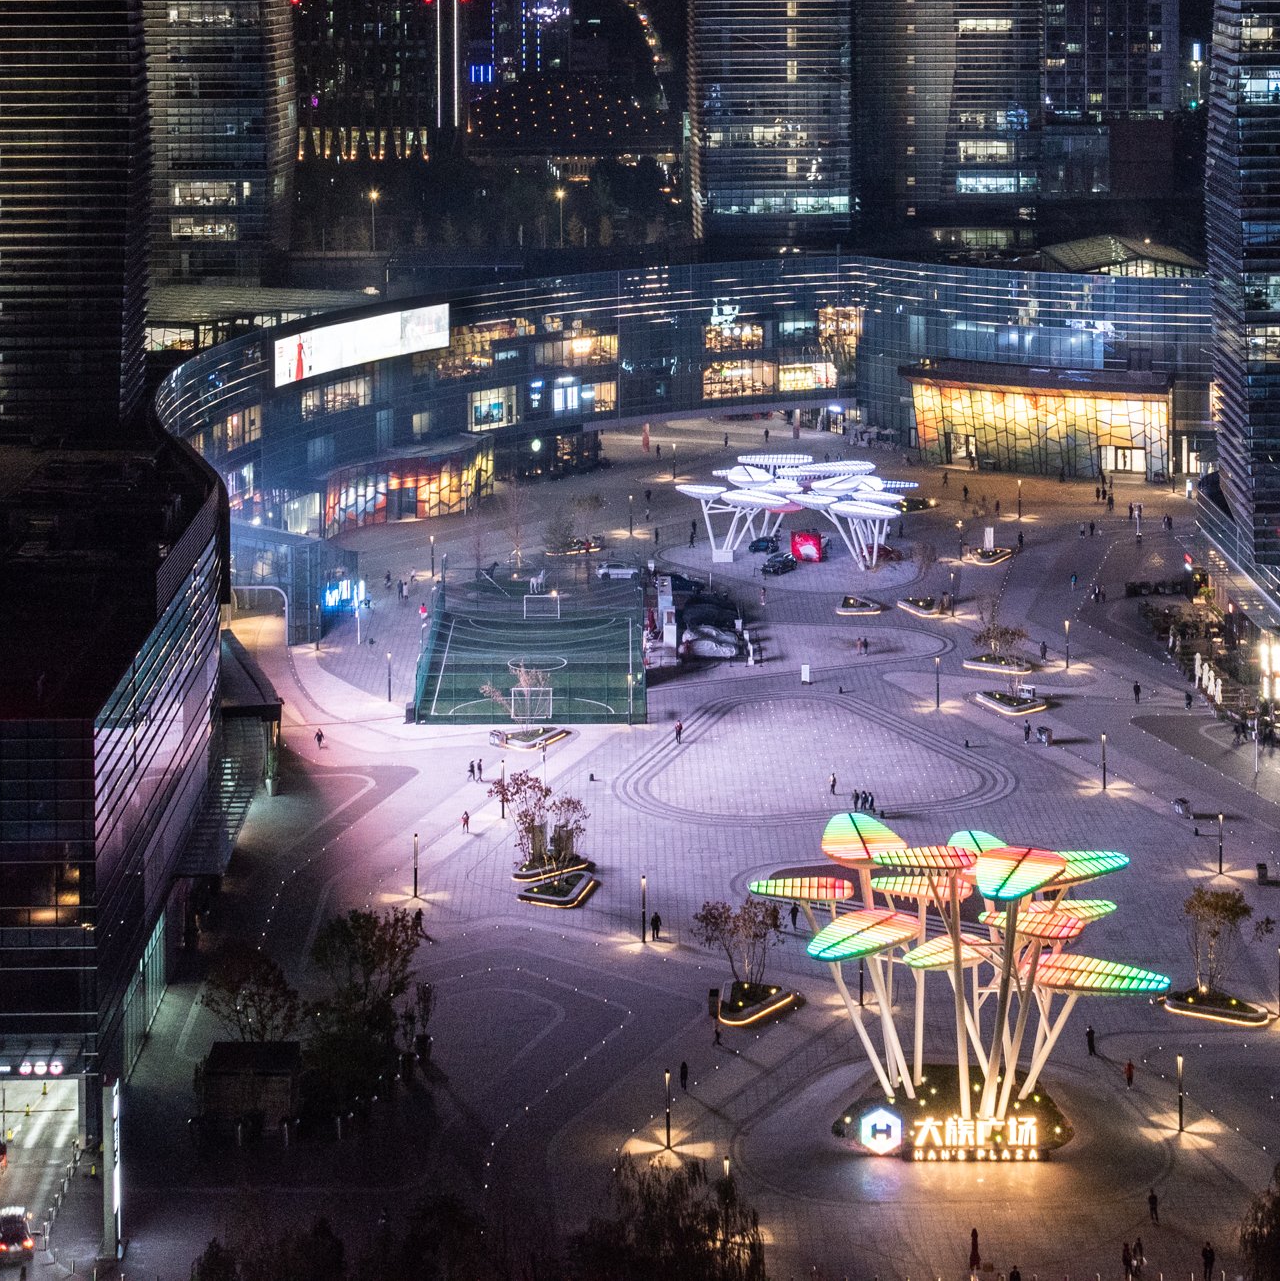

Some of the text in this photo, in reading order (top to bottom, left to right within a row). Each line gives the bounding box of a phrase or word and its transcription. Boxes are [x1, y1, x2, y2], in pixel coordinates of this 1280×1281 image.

[914, 1117, 1037, 1146] 大族广场
[914, 1149, 1038, 1160] HAN'S PLAZA
